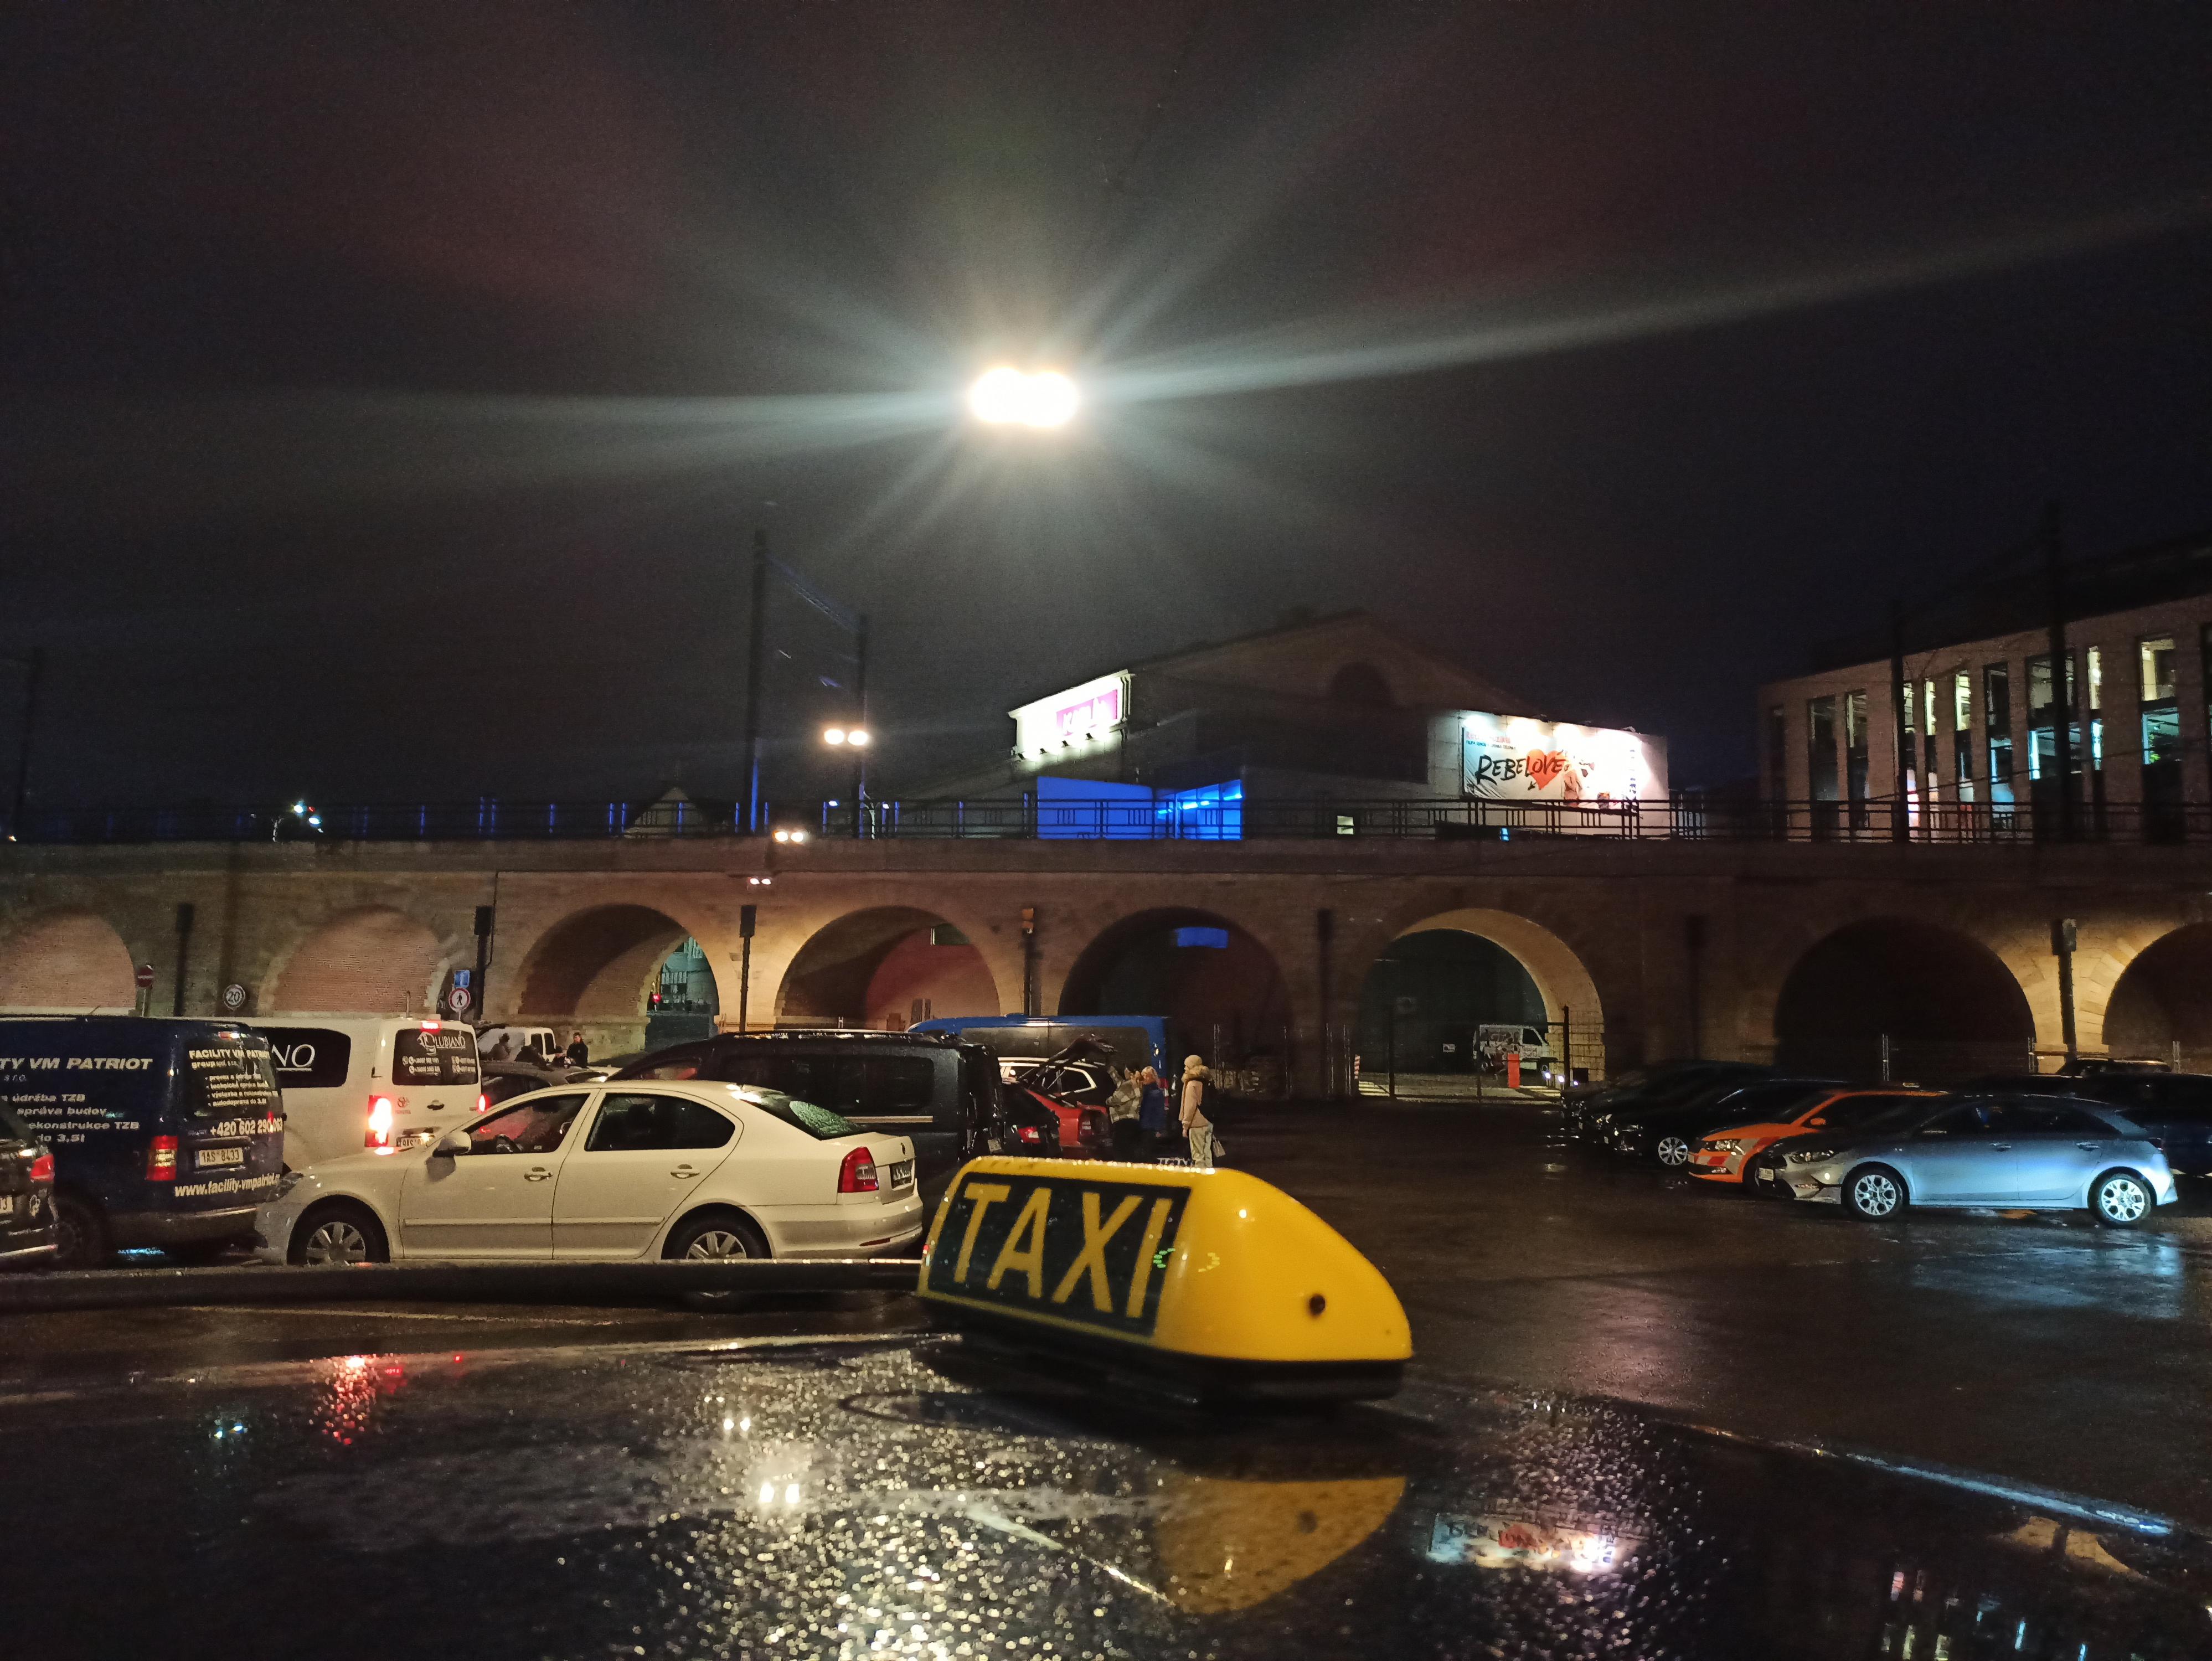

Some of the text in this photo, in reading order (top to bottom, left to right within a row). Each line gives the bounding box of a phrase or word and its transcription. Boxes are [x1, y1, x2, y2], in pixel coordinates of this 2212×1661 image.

[227, 991, 240, 1003] 20
[189, 1049, 230, 1060] FACILITY
[30, 1057, 60, 1070] VM
[66, 1058, 153, 1071] PATRIOT
[192, 1061, 215, 1070] group
[62, 1093, 85, 1102] TZB
[17, 1107, 107, 1117] správa budov
[28, 1121, 110, 1129] ekonstrukce
[210, 1121, 236, 1136] +420
[239, 1120, 255, 1135] 602
[257, 1118, 273, 1133] 290
[953, 1181, 1173, 1318] TAXI
